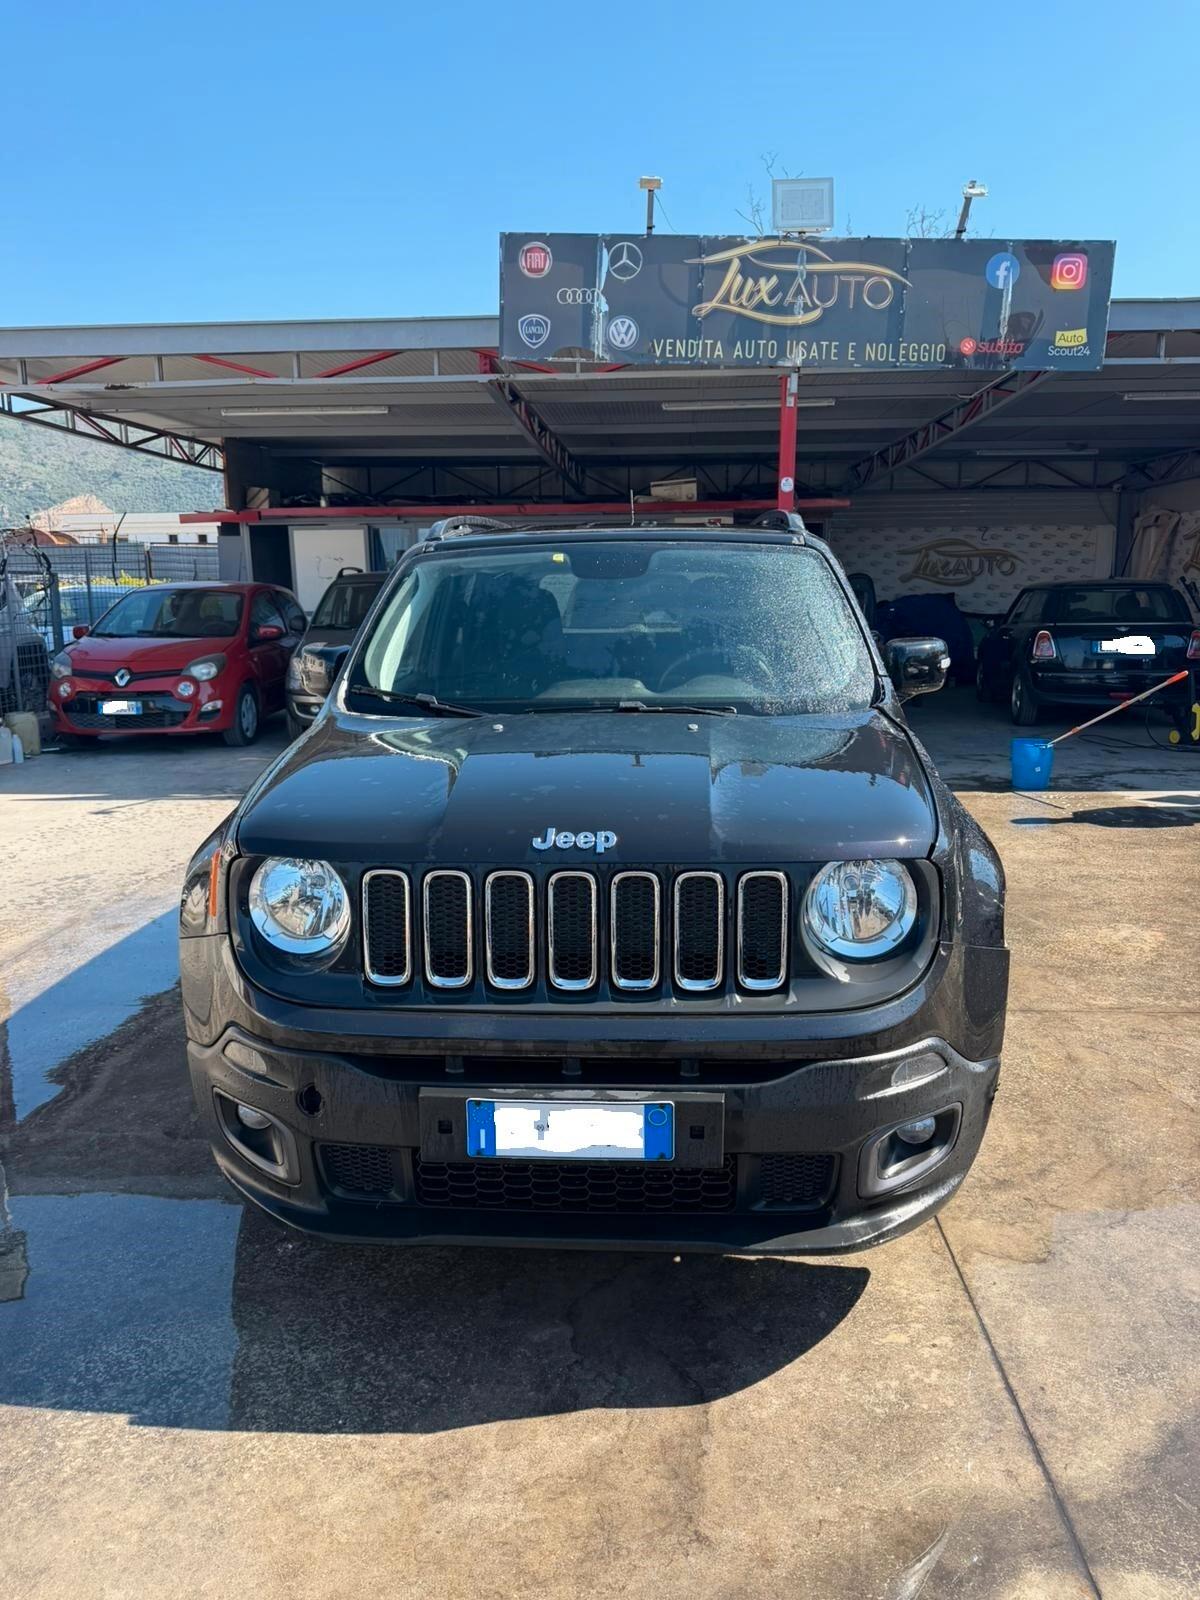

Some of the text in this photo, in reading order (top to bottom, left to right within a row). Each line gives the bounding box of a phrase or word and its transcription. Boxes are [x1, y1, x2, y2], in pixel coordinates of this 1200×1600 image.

[526, 252, 546, 269] FIAT
[692, 256, 894, 318] Lux AUTO
[525, 325, 544, 334] LANCIA
[977, 338, 1025, 354] subito
[1057, 333, 1084, 344] Auto
[653, 338, 946, 362] VENDITA AUTO USATE E NOLEGGIO
[1047, 345, 1091, 356] Scout24
[532, 827, 617, 853] Jeep
